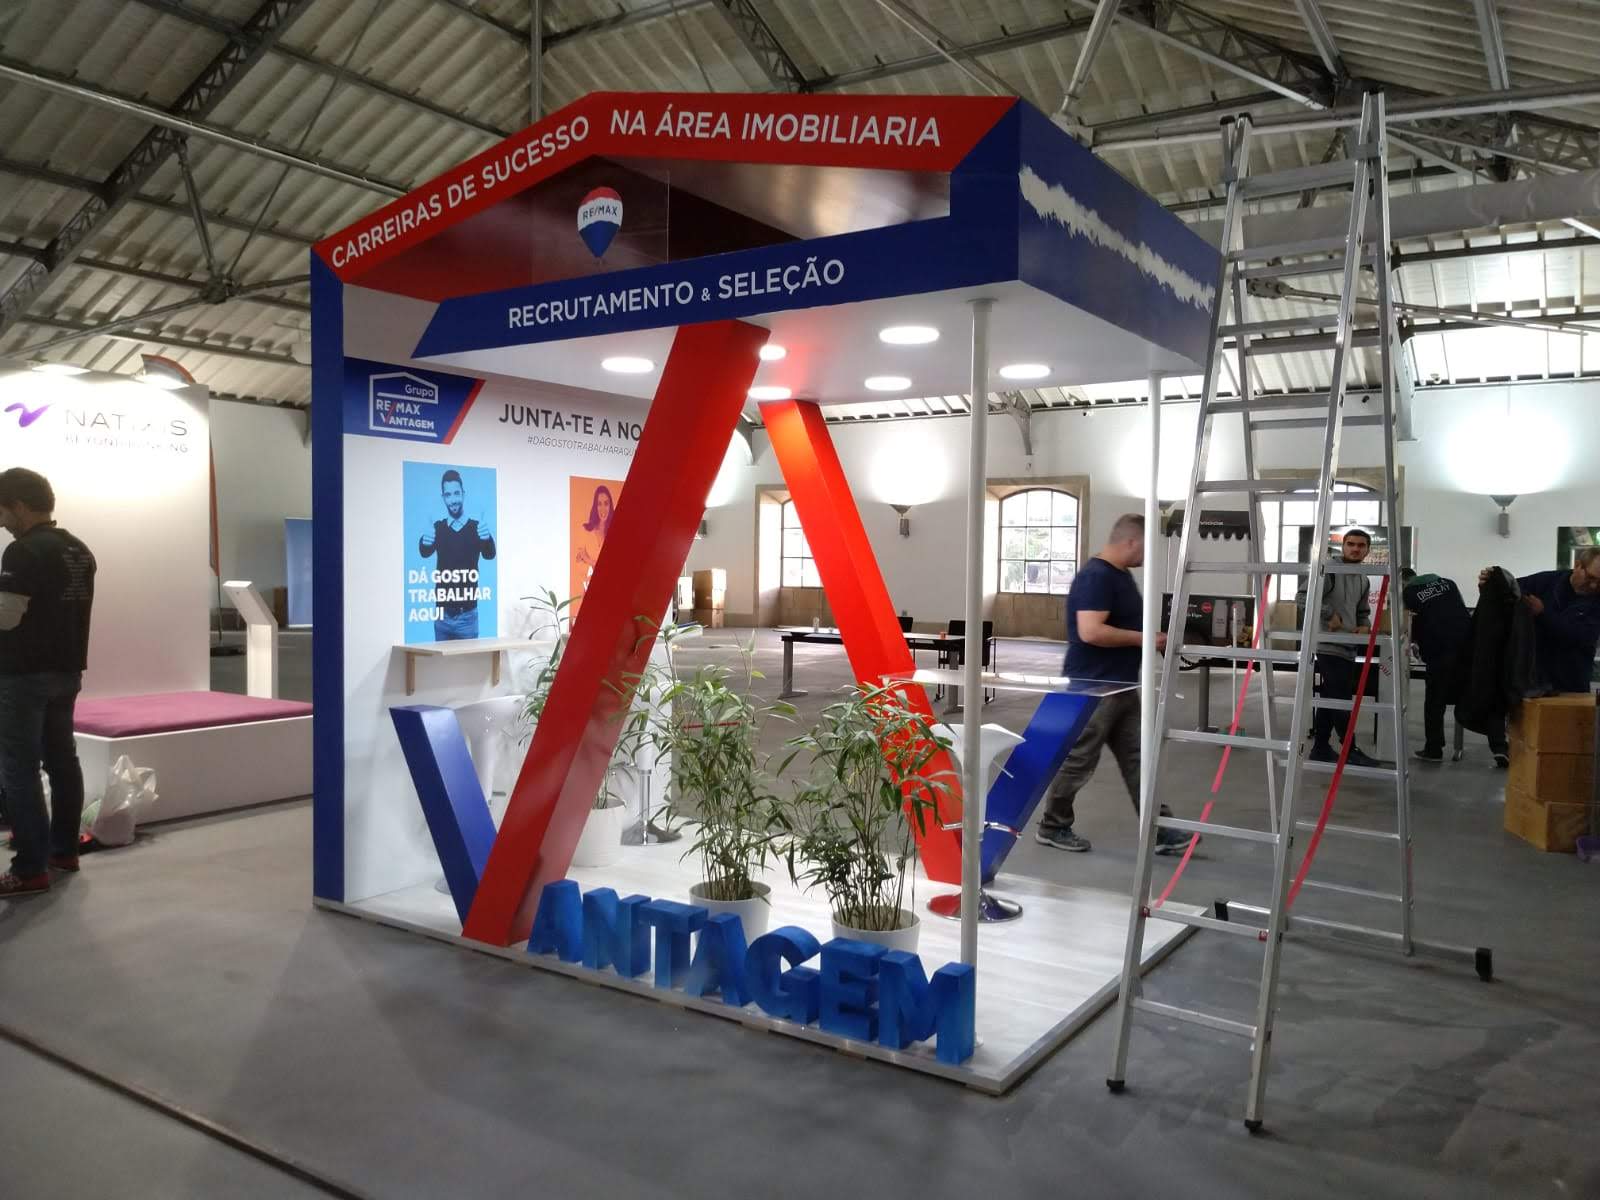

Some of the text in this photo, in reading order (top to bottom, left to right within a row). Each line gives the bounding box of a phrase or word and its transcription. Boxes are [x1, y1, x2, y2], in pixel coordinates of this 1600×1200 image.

[610, 103, 941, 147] NA ÁREA IMOBILIARIA
[331, 115, 590, 268] CARREIRAS DE SUCESSO
[583, 205, 618, 220] RE/MAX
[508, 256, 845, 329] RECRUTAMENTO & SELEÇÃO
[405, 384, 434, 397] Grupo
[376, 399, 421, 415] RE/MAX
[380, 412, 434, 429] VANTAGEM
[499, 403, 594, 435] JUNTA-TE
[600, 419, 612, 437] A
[408, 566, 479, 584] DÁ GOSTO
[408, 586, 492, 603] TRABALHAR
[1416, 583, 1450, 601] DISPLAY
[409, 606, 444, 623] AQUI
